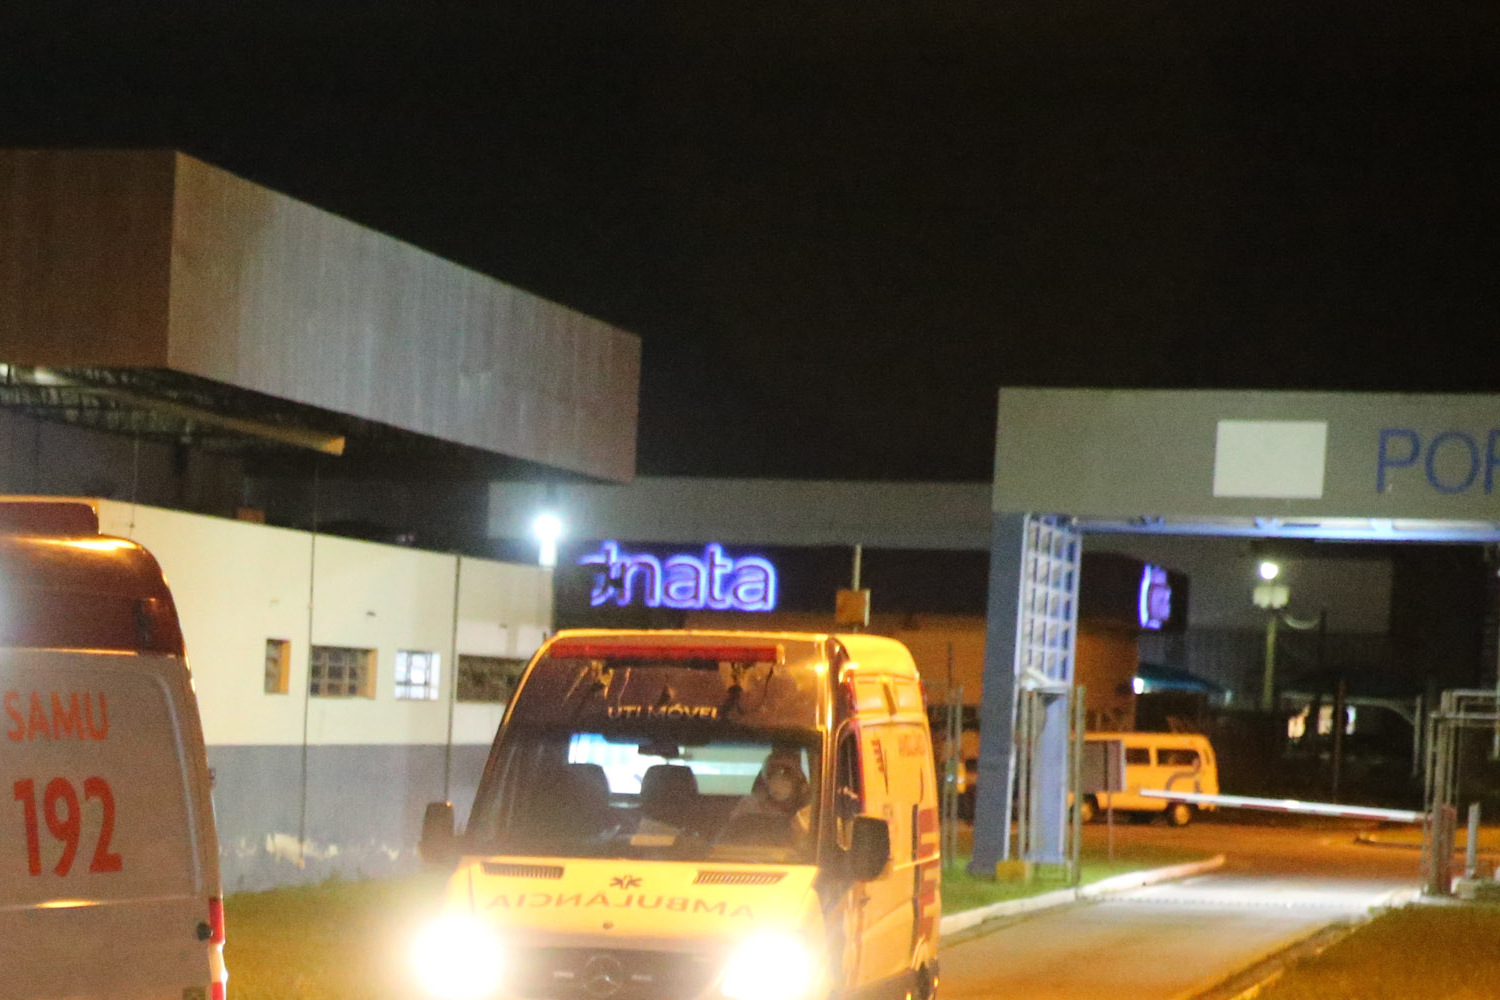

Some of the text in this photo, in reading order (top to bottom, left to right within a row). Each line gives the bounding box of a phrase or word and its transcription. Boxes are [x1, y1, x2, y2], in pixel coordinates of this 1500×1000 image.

[4, 690, 109, 742] SAMU
[608, 705, 642, 719] UTI
[13, 776, 123, 877] 192
